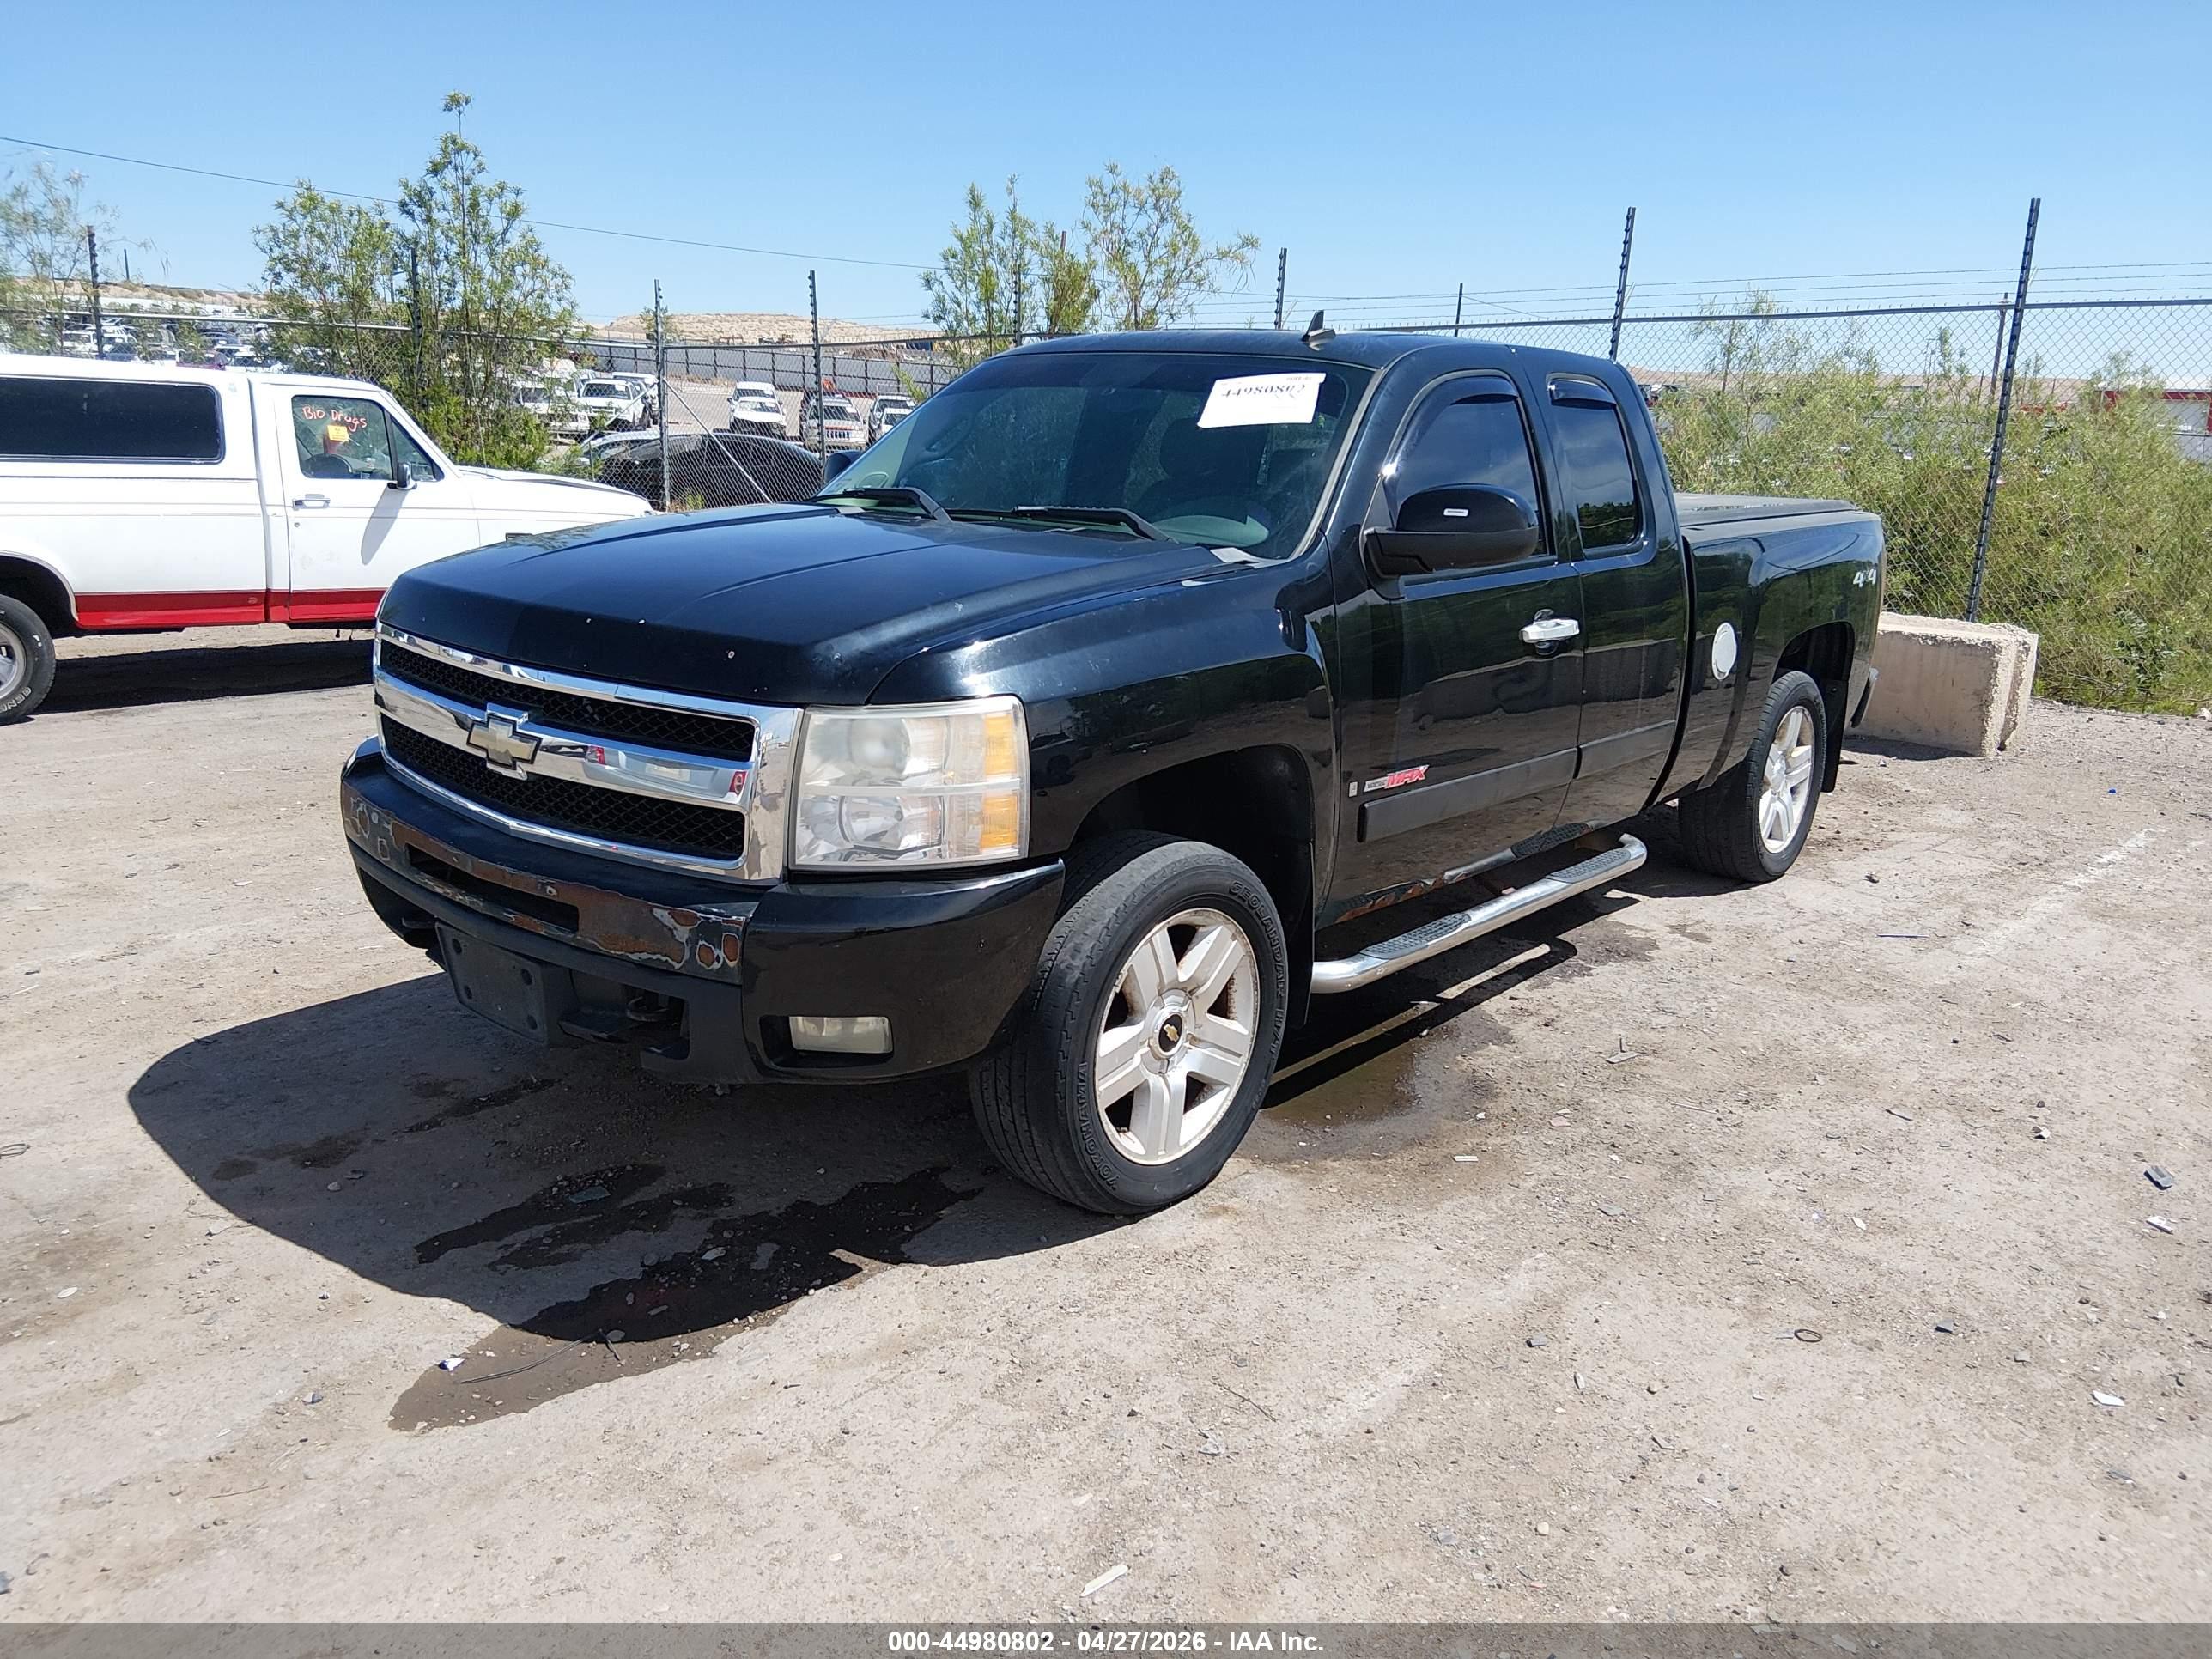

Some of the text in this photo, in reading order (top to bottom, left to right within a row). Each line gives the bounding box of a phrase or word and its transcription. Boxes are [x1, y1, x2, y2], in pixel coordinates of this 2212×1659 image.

[302, 404, 368, 433] Bio Drugs
[1077, 1060, 1121, 1192] YOKOHAMA
